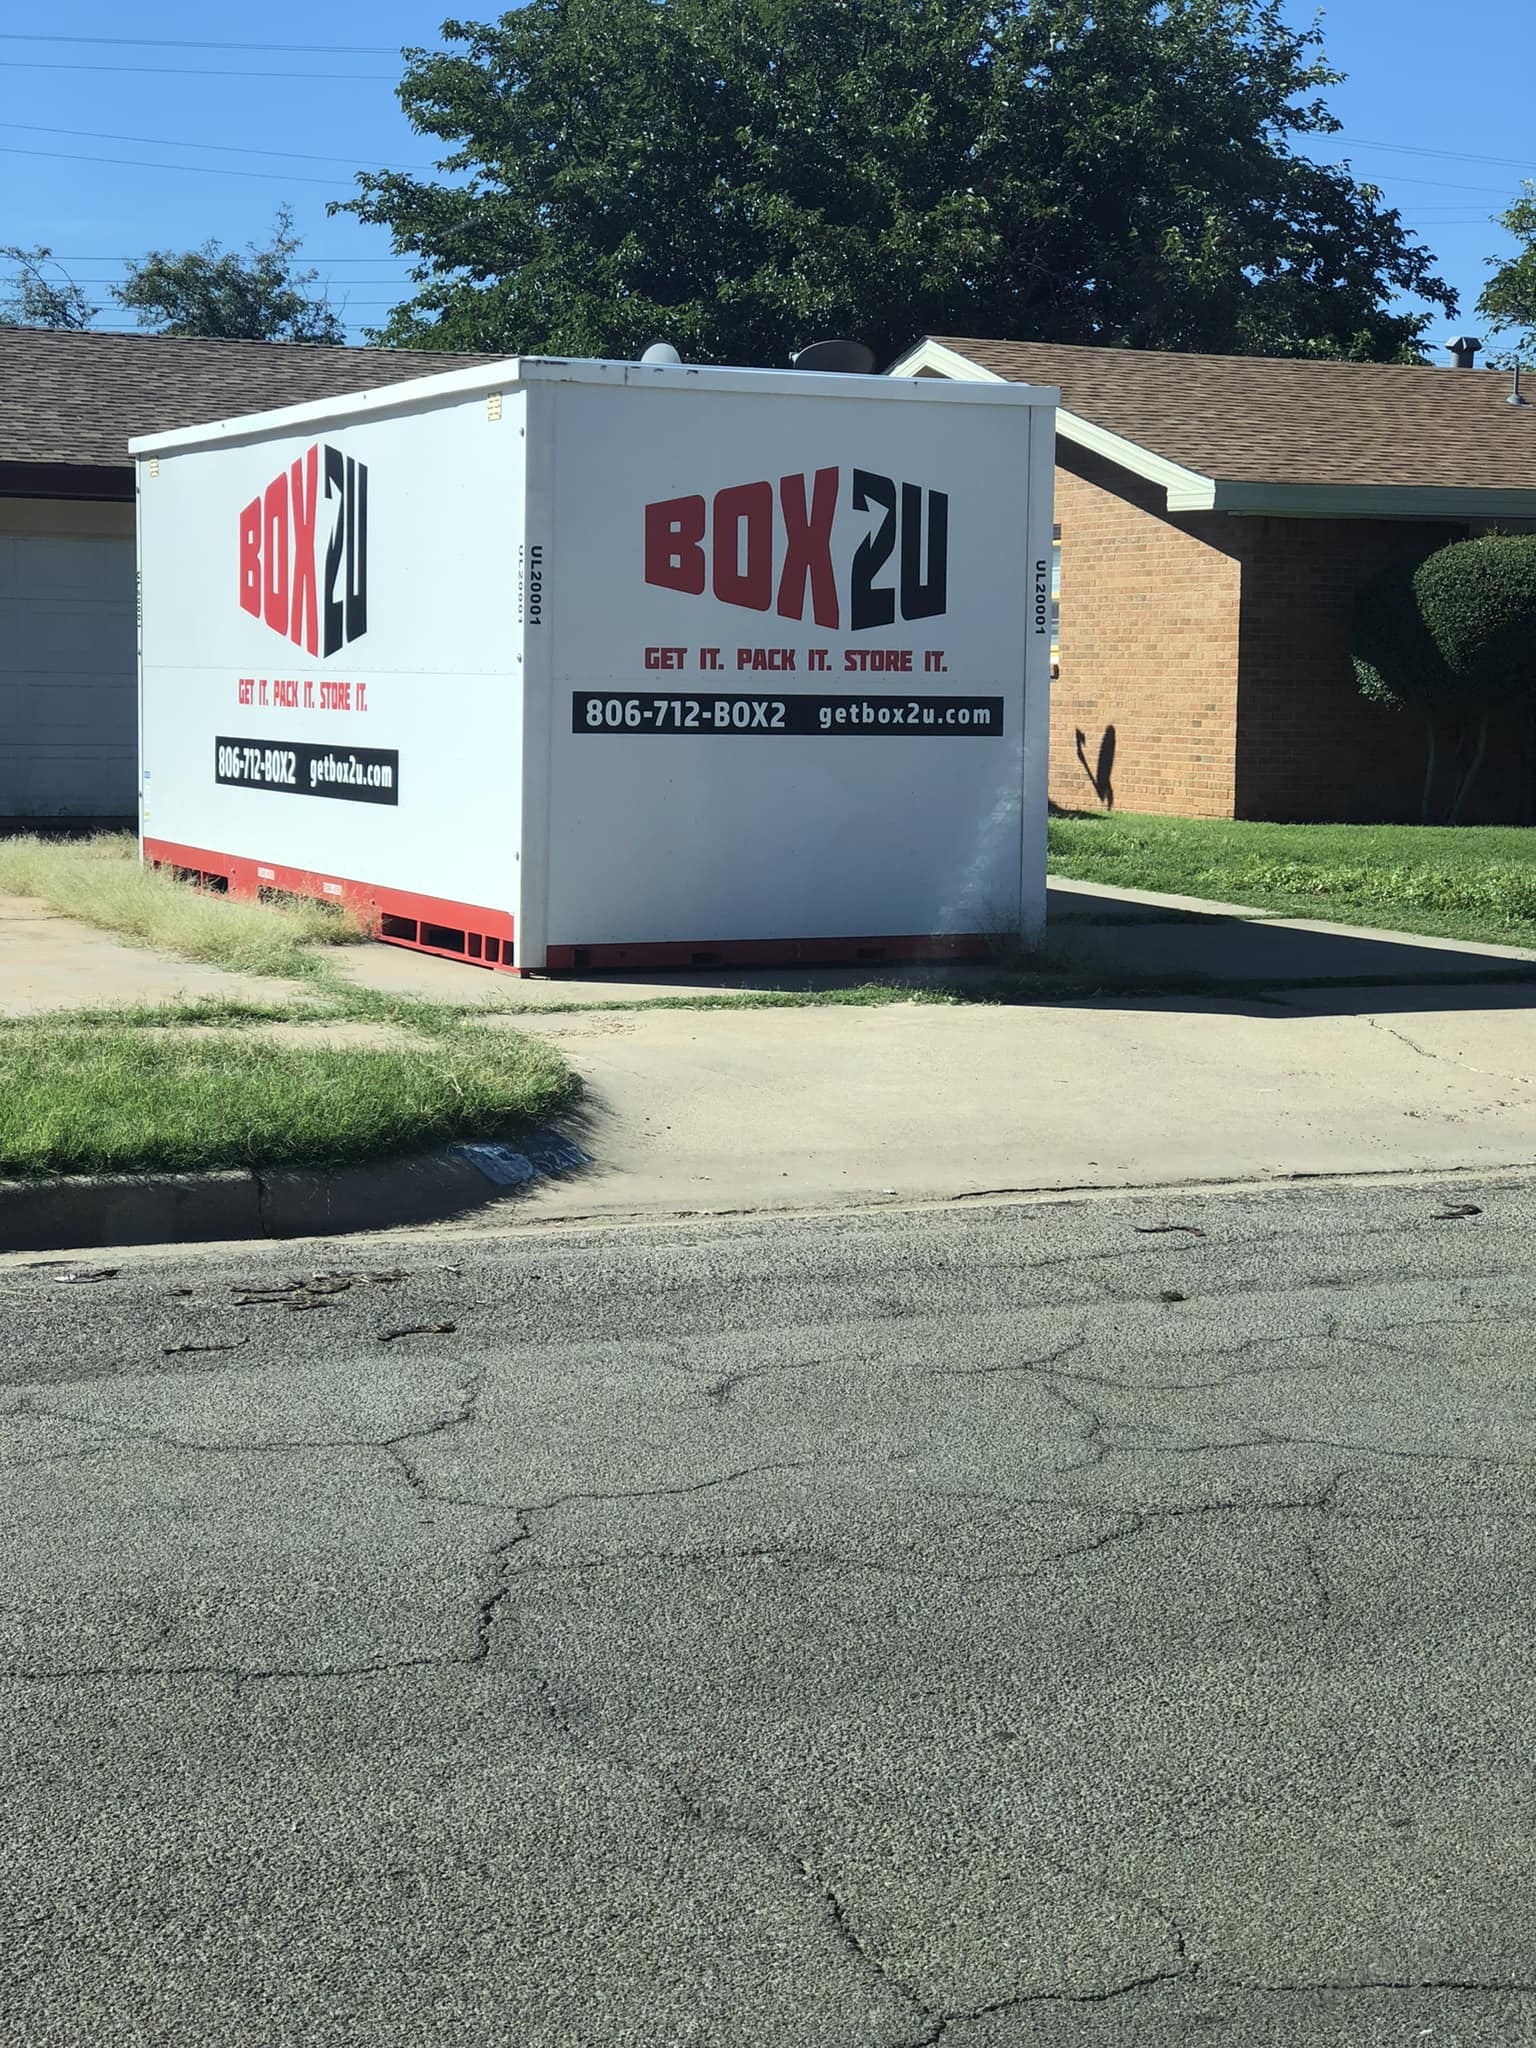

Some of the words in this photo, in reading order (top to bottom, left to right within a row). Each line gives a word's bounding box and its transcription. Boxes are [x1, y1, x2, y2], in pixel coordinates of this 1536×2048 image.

[239, 443, 368, 659] BOX2U
[644, 466, 949, 631] BOX2U
[530, 545, 543, 625] UL20001
[1035, 560, 1046, 635] UL20001
[644, 647, 688, 670] GET
[699, 648, 725, 670] IT.
[737, 648, 796, 671] PACK
[808, 649, 832, 671] IT.
[844, 649, 912, 672] STORE
[924, 650, 948, 672] IT.
[238, 679, 255, 705] GET
[258, 680, 269, 706] IT.
[273, 680, 299, 708] PACK
[303, 681, 315, 709] IT.
[320, 681, 351, 711] STORE
[356, 682, 368, 712] IT.
[585, 699, 786, 728] 806-712-BOX2
[818, 702, 991, 729] getbox2u.com
[218, 745, 296, 784] 806-712-BOX2
[310, 753, 393, 788] getbox2u.com
